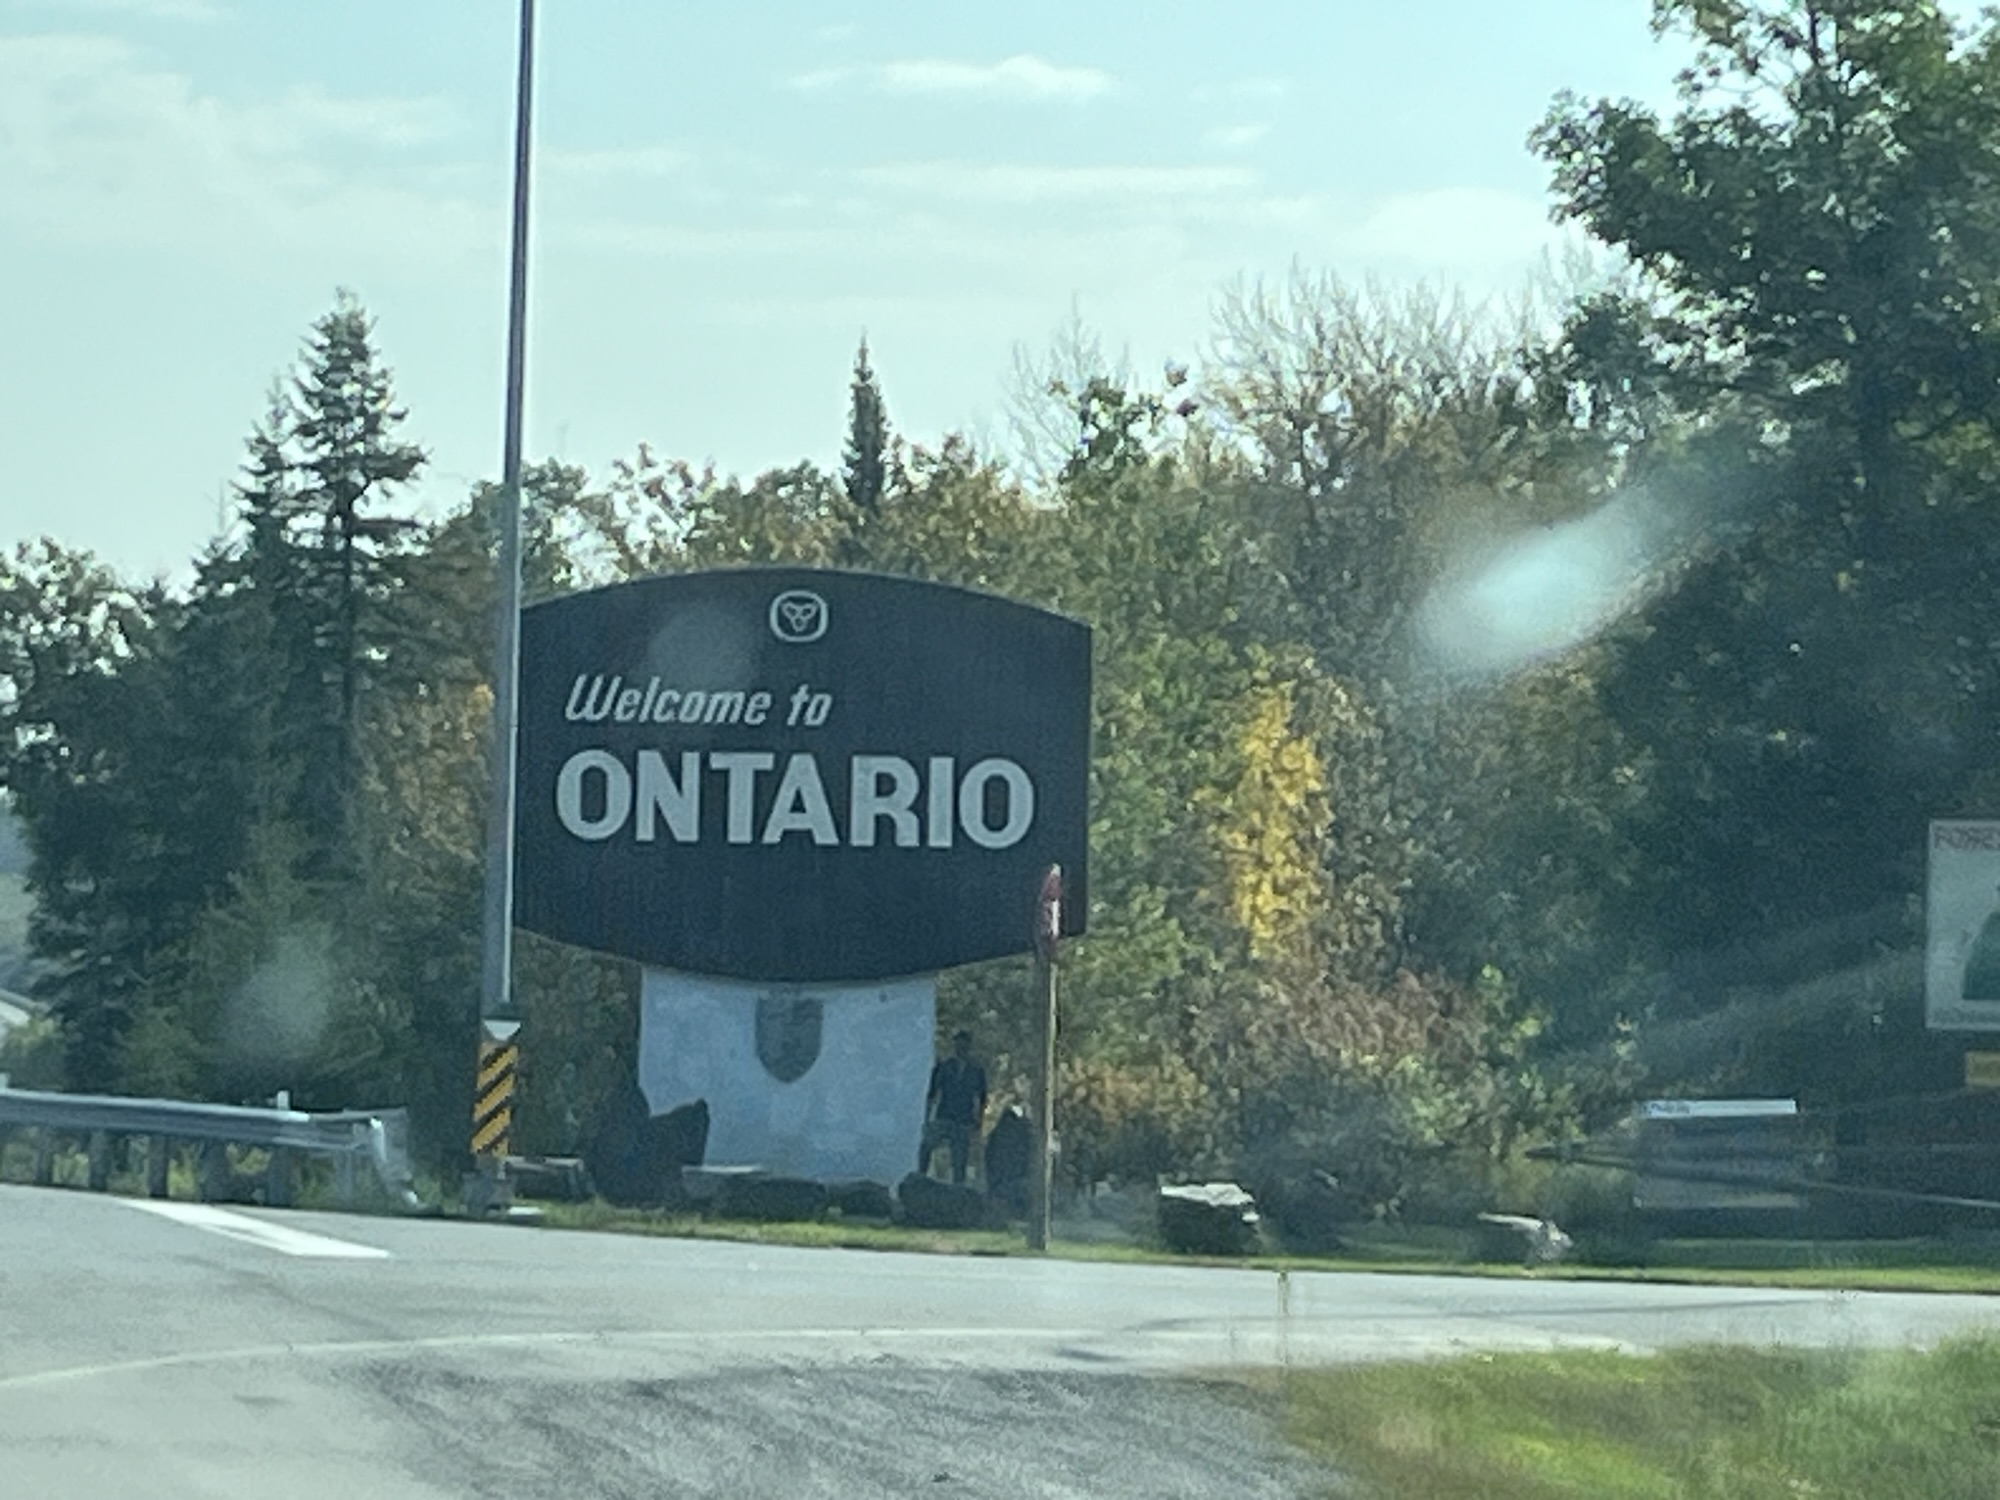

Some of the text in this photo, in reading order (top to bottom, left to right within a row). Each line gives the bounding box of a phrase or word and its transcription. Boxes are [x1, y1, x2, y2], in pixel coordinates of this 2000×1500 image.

[565, 674, 832, 726] Welcome to
[556, 749, 1035, 848] ONTARIO
